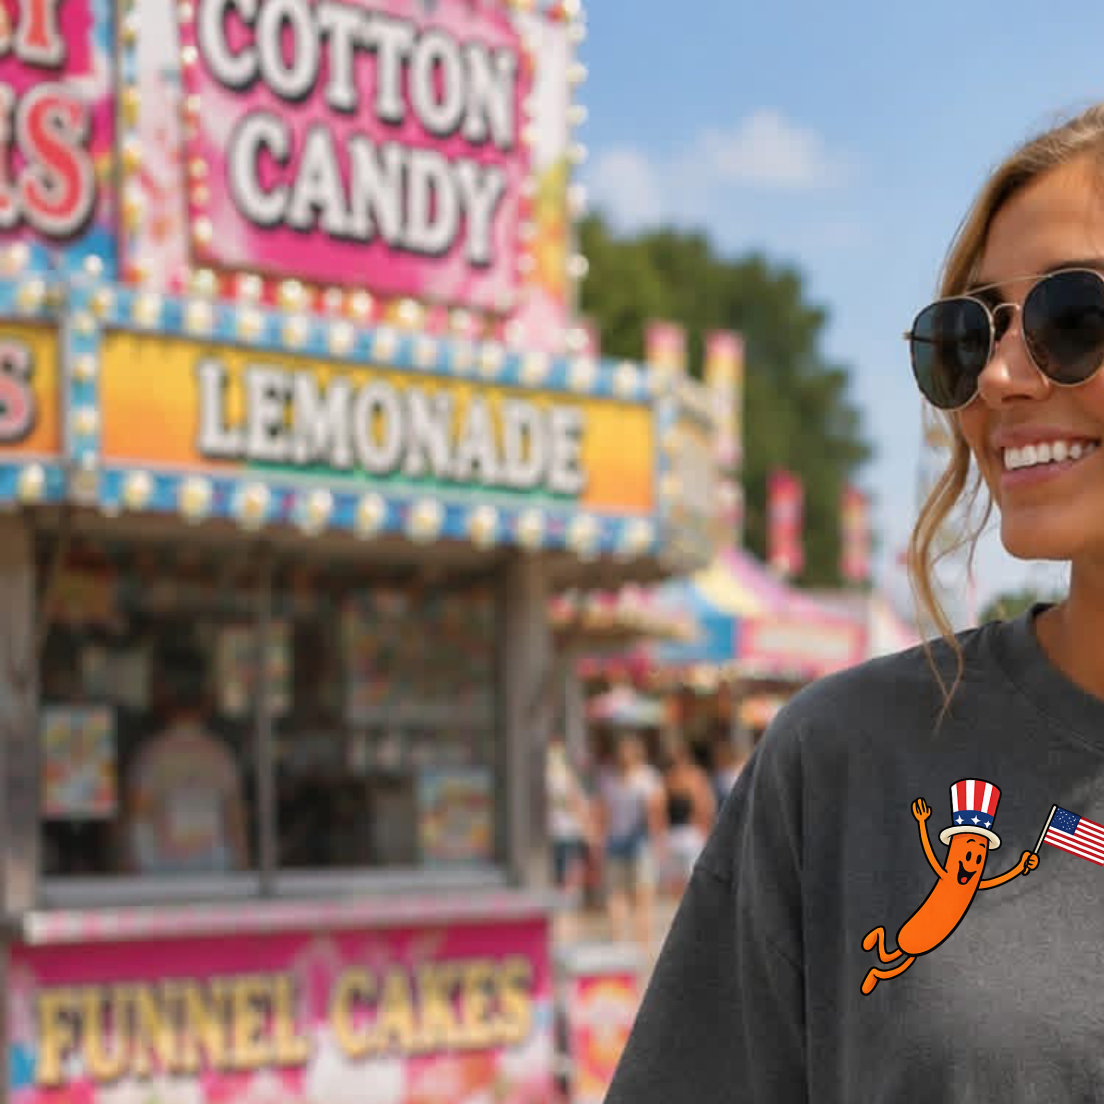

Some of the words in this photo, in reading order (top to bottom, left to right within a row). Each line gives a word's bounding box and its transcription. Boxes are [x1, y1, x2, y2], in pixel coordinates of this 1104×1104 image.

[202, 0, 517, 150] COTTON
[229, 111, 505, 268] CANDY
[196, 360, 584, 495] LEMONADE
[36, 974, 308, 1085] FUNNEL
[330, 956, 534, 1060] CAKES
